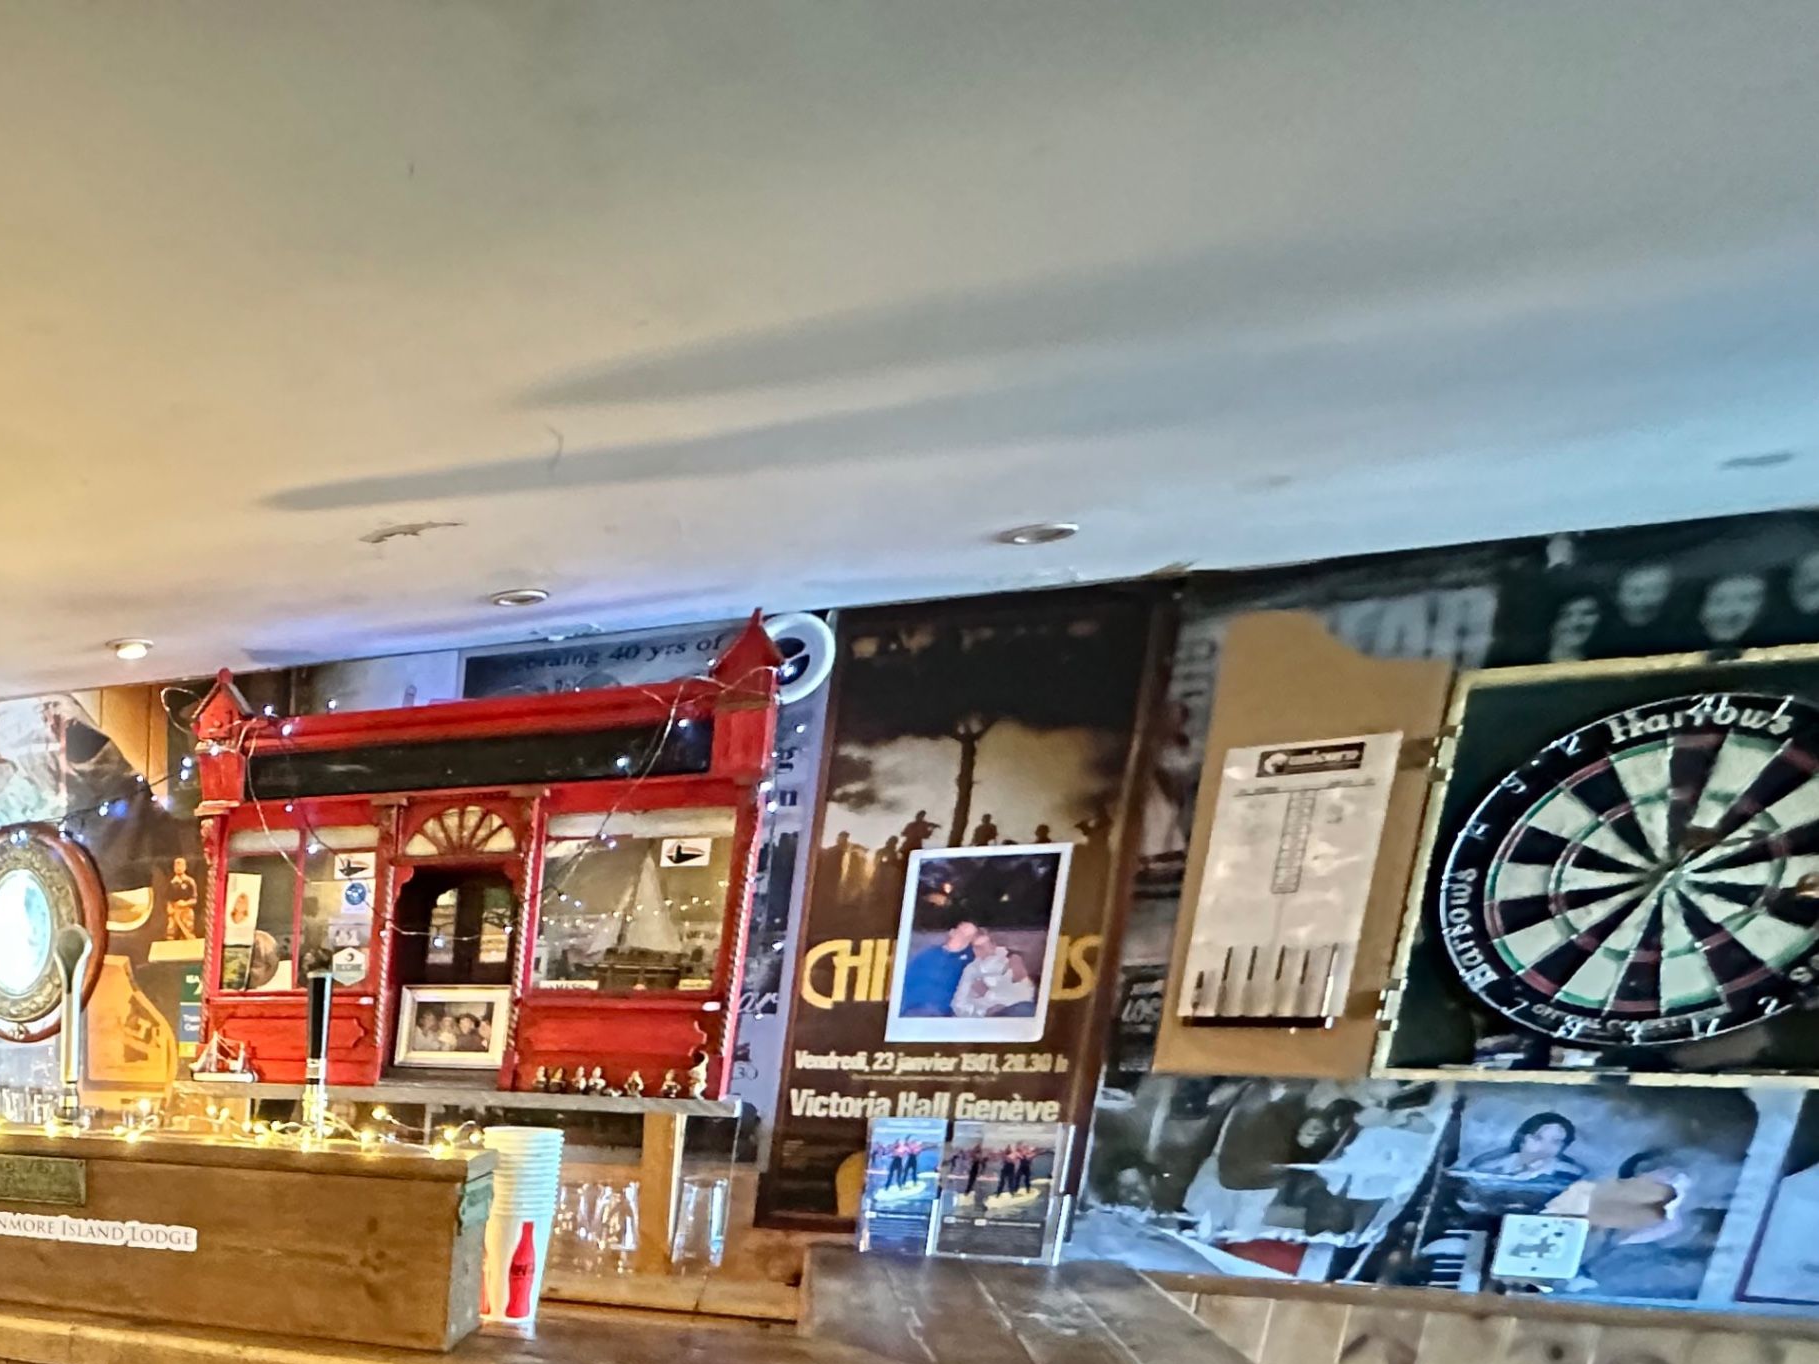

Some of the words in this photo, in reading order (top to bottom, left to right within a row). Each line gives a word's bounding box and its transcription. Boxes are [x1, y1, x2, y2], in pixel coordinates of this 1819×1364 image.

[610, 643, 641, 661] 40
[872, 1052, 895, 1071] 23
[896, 1052, 958, 1074] janvier
[790, 1089, 892, 1118] Victoria
[897, 1091, 950, 1119] Hall
[955, 1093, 1061, 1122] Genève
[60, 1219, 125, 1242] ISLAND
[131, 1226, 193, 1247] LODGE
